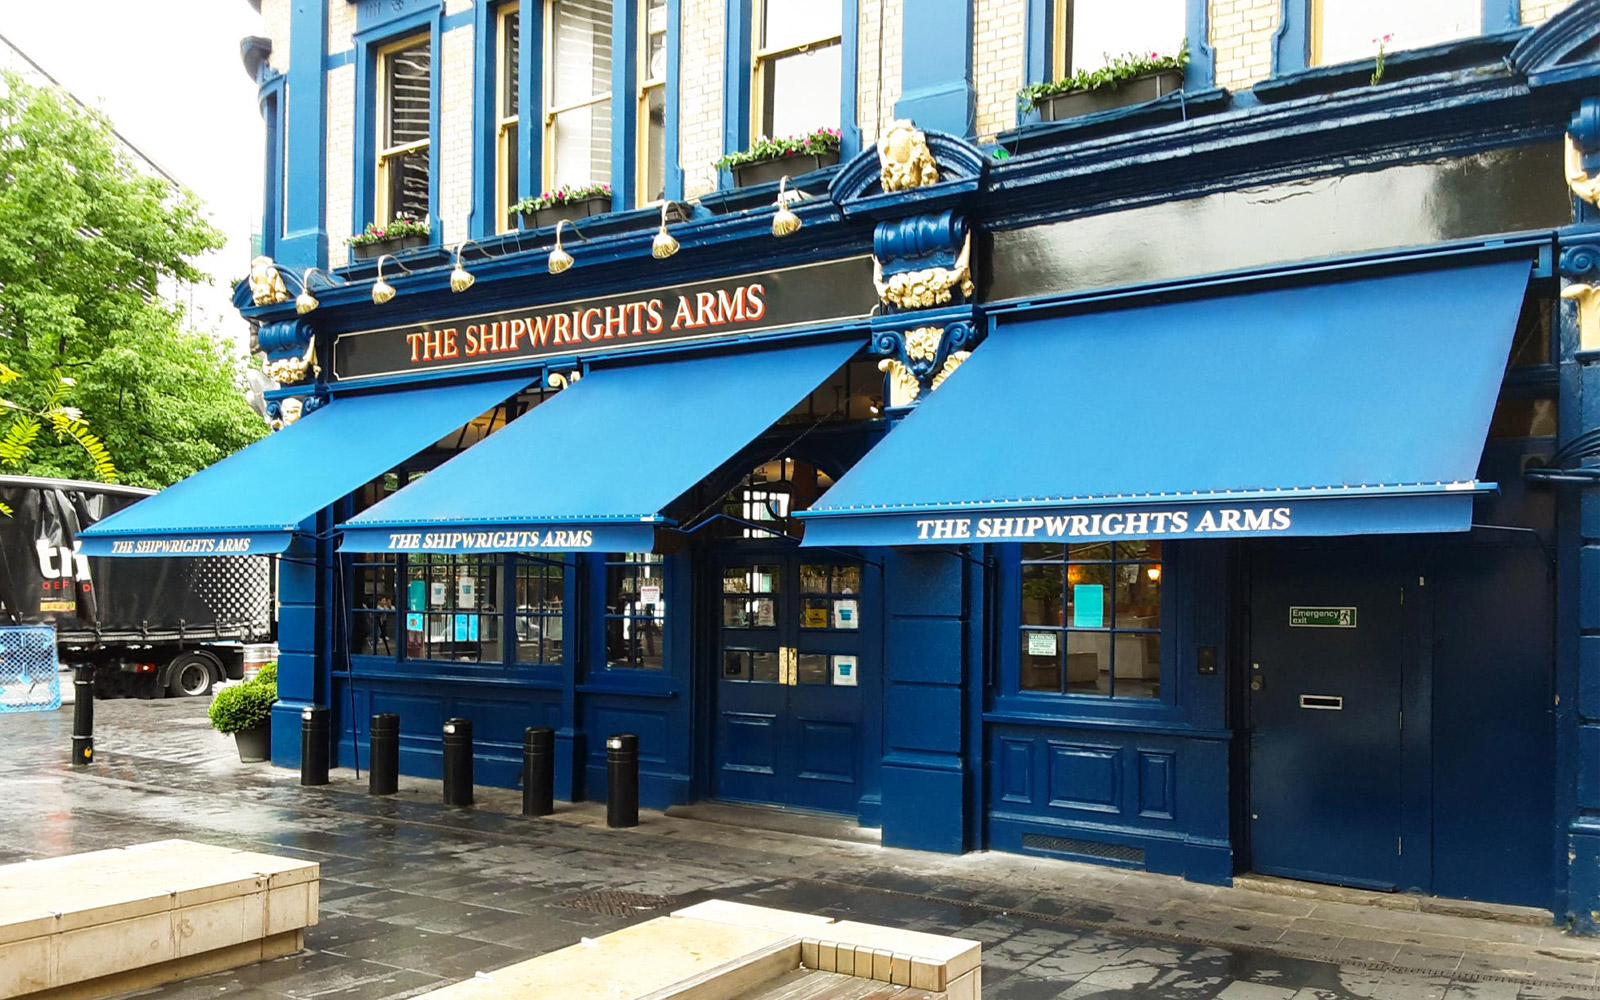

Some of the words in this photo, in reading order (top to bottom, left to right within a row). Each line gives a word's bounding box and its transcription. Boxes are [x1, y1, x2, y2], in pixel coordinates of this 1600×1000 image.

[406, 328, 458, 362] THE
[464, 299, 664, 356] SHIPWRIGHTS
[670, 283, 766, 330] ARMS
[916, 518, 971, 540] THE
[975, 510, 1189, 538] SHIPWRIGHTS
[1194, 507, 1292, 533] ARMS
[111, 541, 135, 553] THE
[134, 539, 215, 553] SHIPWRIGHTS
[214, 538, 250, 552] ARMS
[388, 533, 422, 549] THE
[422, 531, 540, 549] SHIPWRIGHTS
[540, 530, 593, 548] ARMS
[1292, 609, 1339, 619] Emergency
